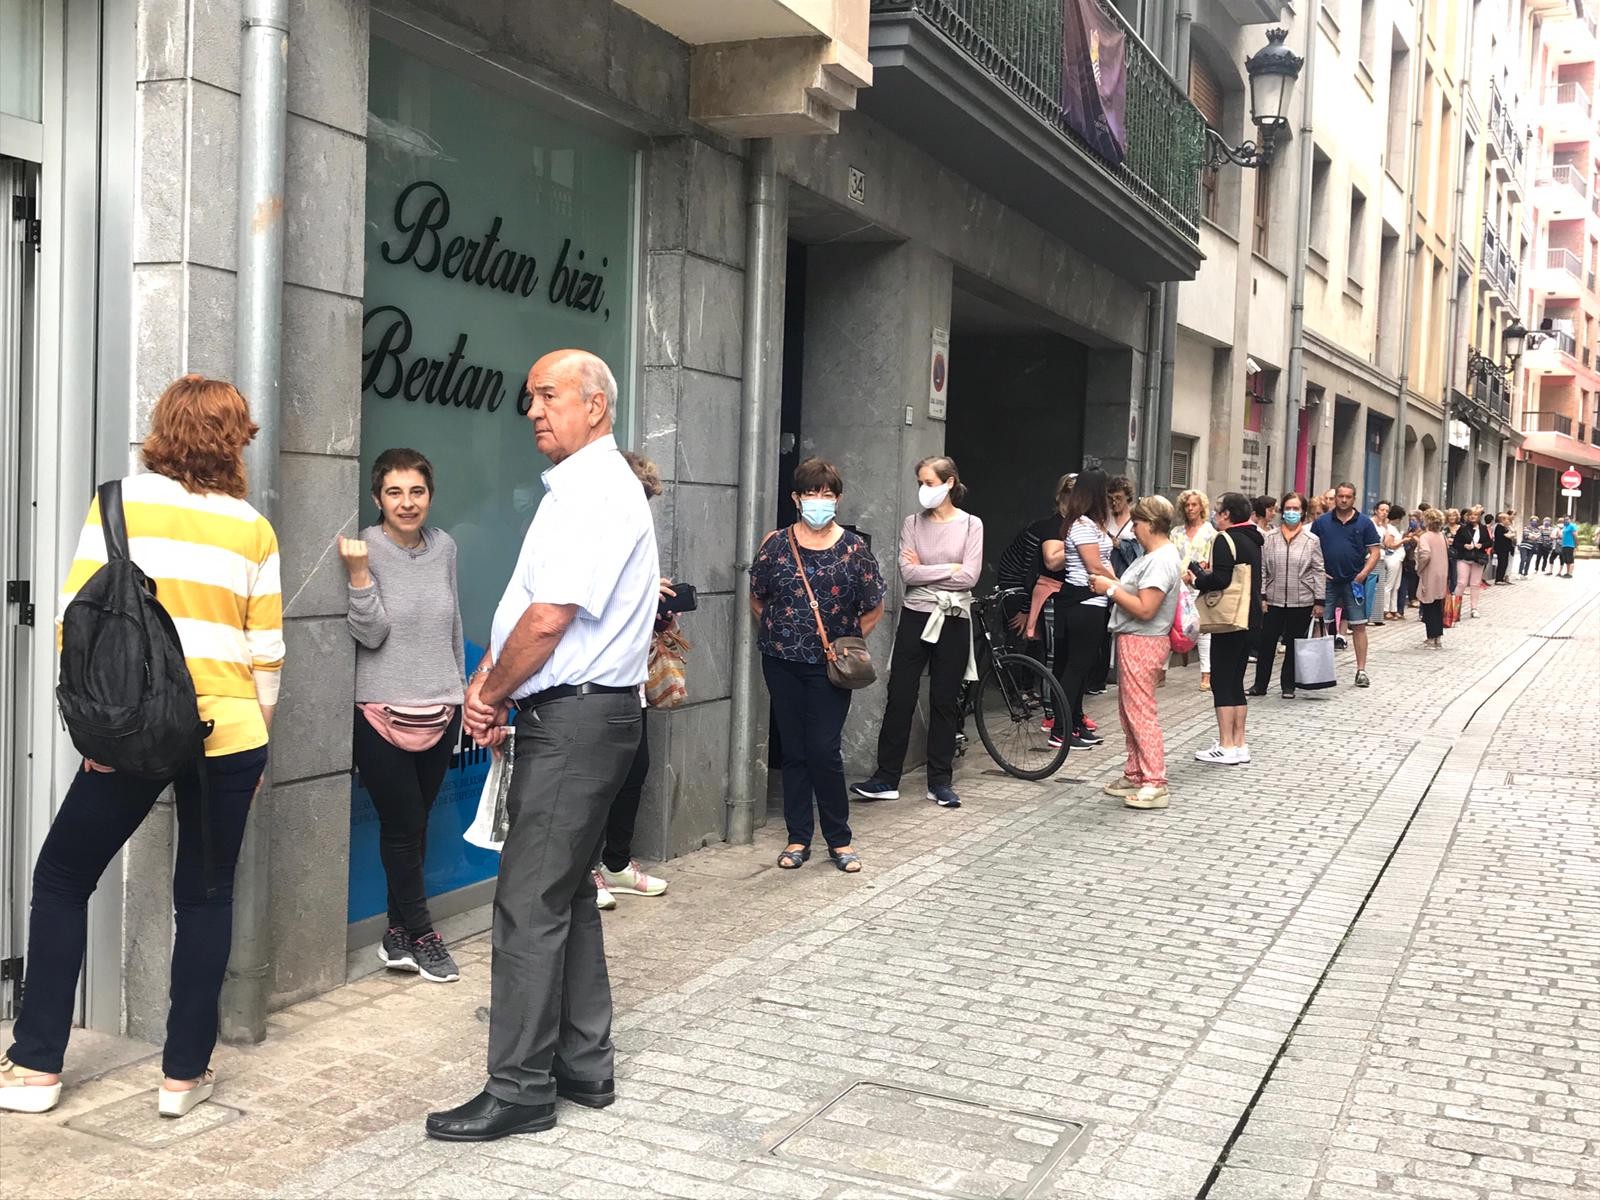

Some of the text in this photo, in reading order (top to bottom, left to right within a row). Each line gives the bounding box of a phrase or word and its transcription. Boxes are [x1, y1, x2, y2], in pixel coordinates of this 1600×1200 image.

[851, 172, 863, 197] 34
[381, 181, 610, 322] Bertan bizi,
[361, 305, 506, 413] Bertan
